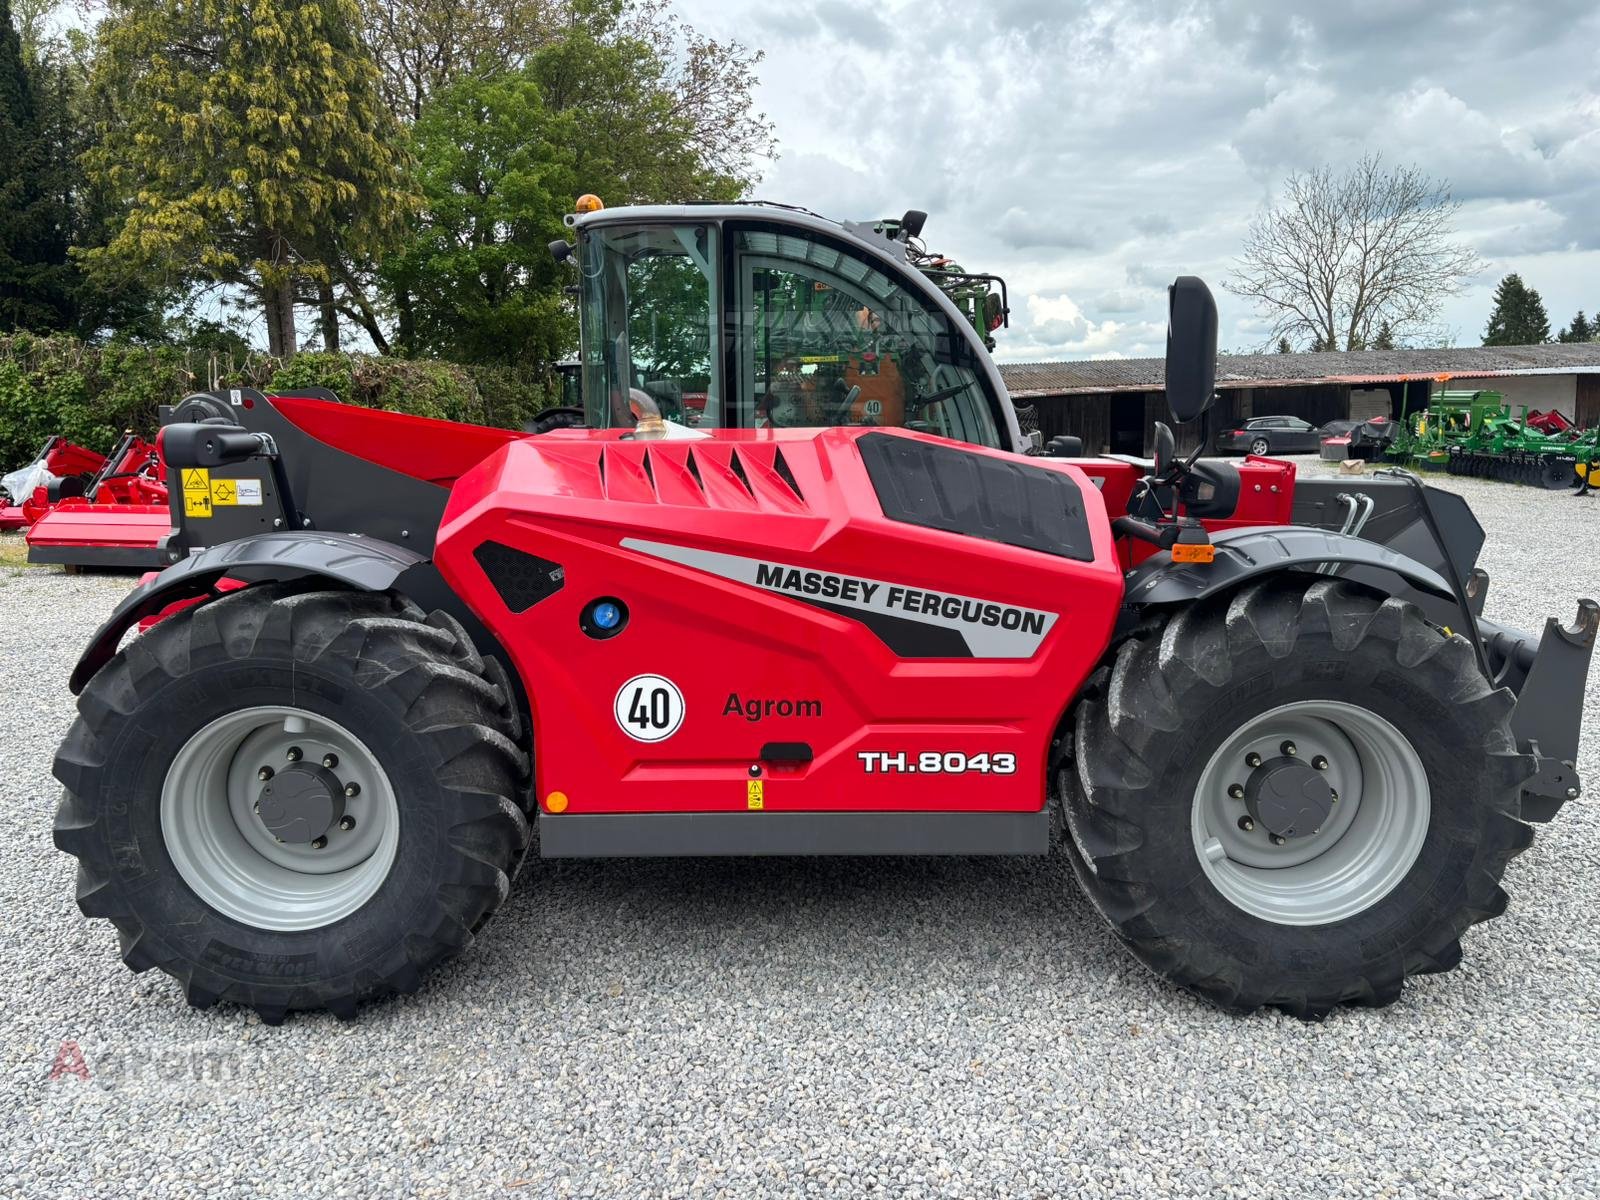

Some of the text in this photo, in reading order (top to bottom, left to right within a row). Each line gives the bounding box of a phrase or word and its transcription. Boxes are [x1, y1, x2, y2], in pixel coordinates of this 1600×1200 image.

[867, 402, 880, 413] 40
[756, 562, 1046, 635] MASSEY FERGUSON
[628, 687, 670, 729] 40
[722, 693, 823, 721] Agrom
[857, 751, 1018, 775] TH.8043
